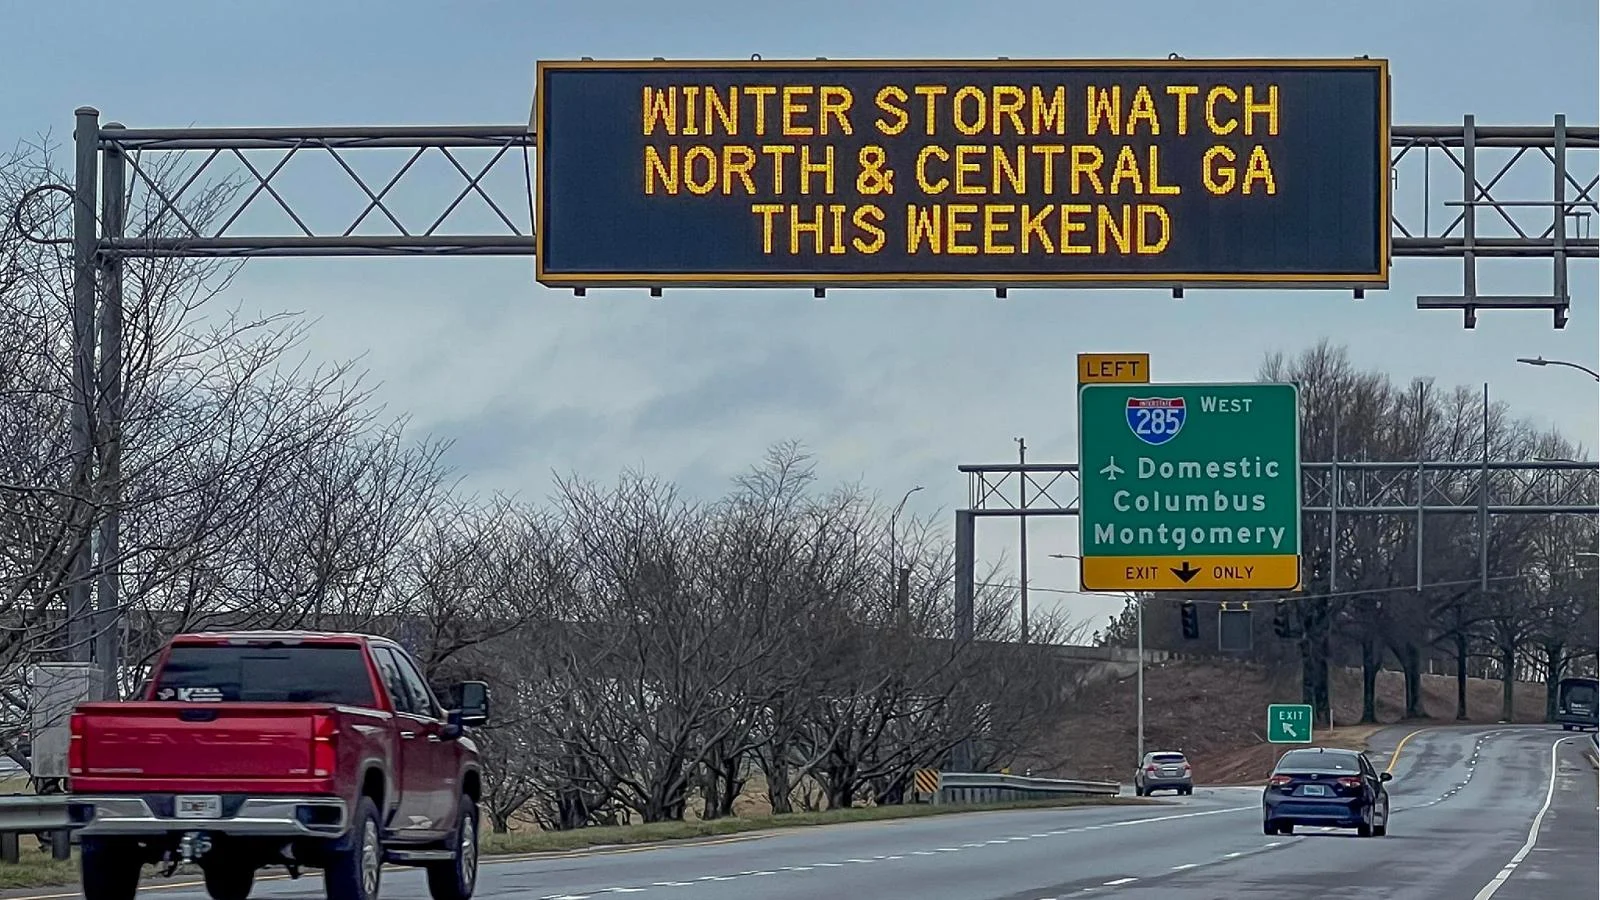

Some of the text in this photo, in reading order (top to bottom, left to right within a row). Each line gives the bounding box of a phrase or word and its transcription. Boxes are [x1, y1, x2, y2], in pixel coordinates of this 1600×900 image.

[643, 85, 1279, 136] WINTER STORM WATCH
[645, 145, 1277, 195] NORTH & CENTRAL GA
[751, 203, 1170, 255] THIS WEEKEND
[1086, 361, 1140, 377] LEFT
[1200, 396, 1252, 412] WEST
[1136, 408, 1180, 434] 285
[1138, 456, 1279, 478] Domestic
[1113, 490, 1266, 511] Columbus
[1094, 523, 1285, 550] Montgomery
[1126, 566, 1254, 580] EXIT ONLY
[1279, 711, 1303, 720] EXIT
